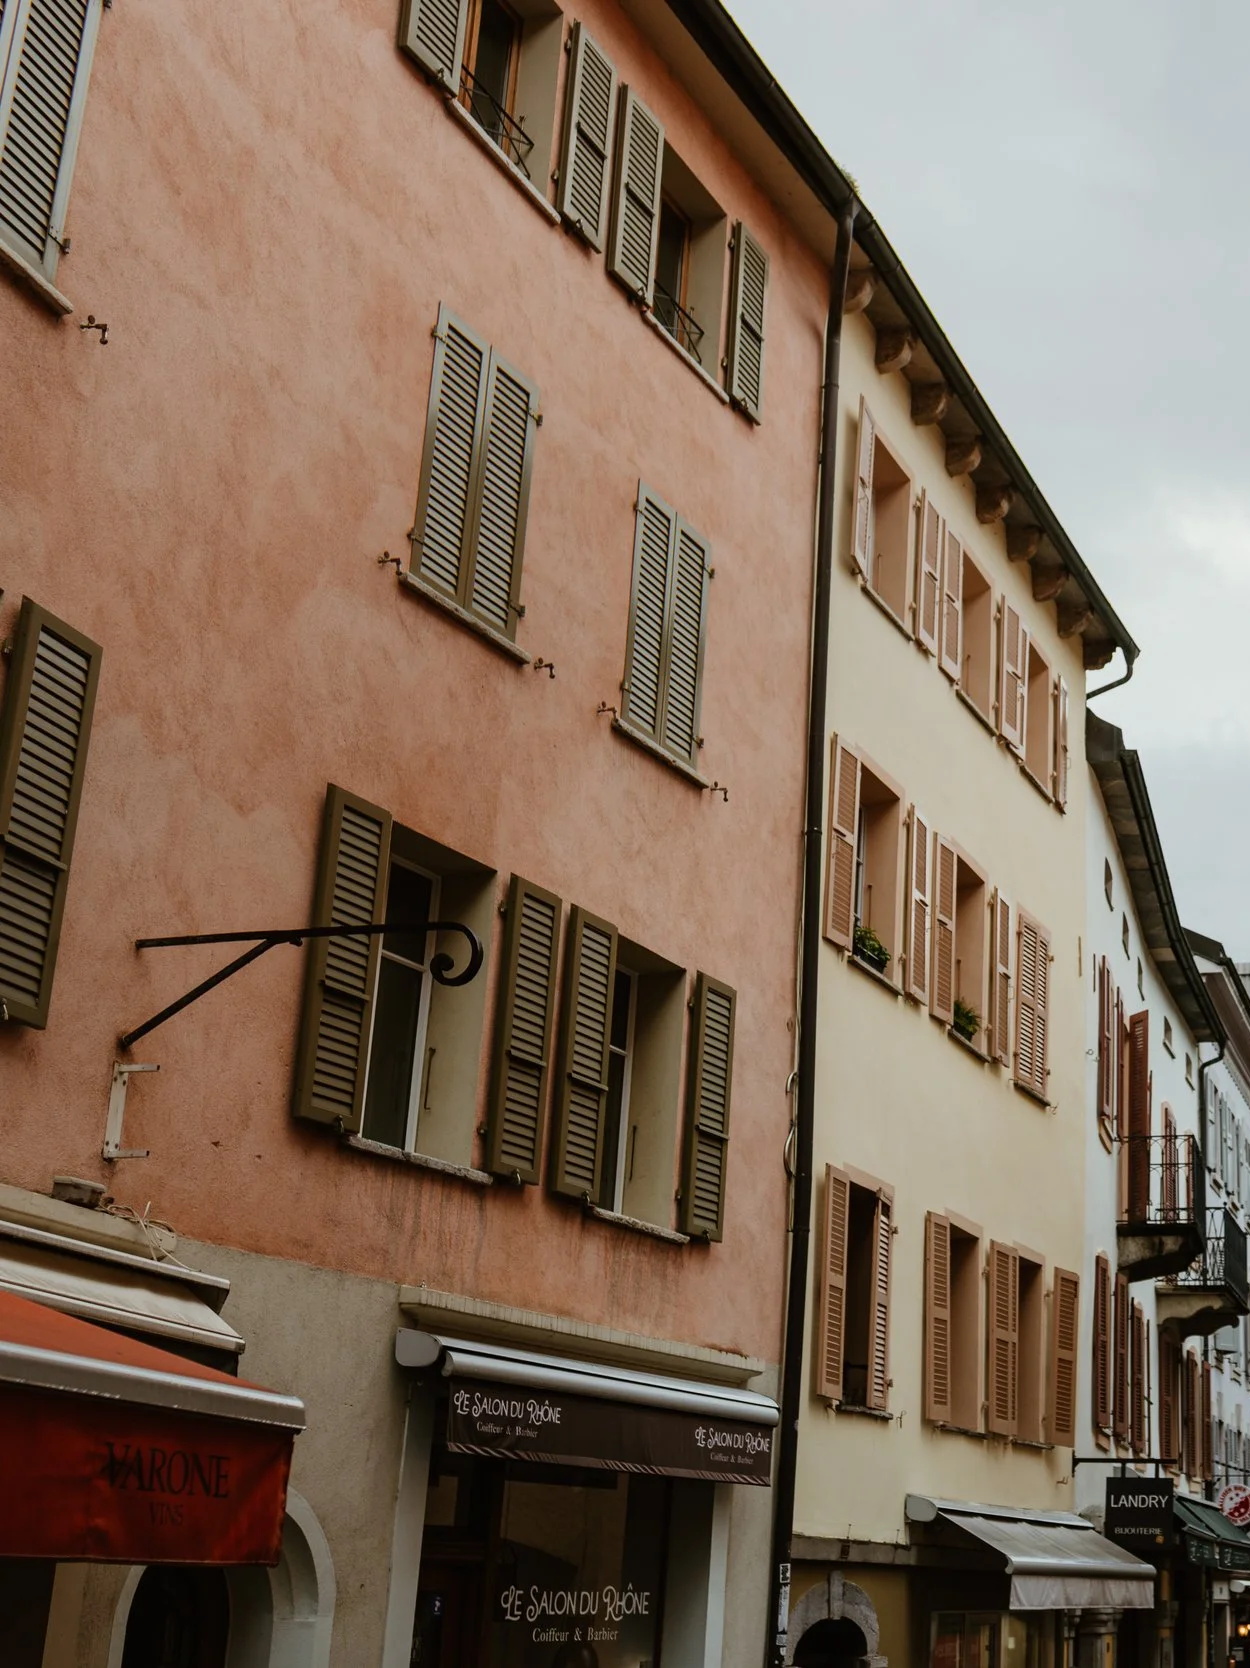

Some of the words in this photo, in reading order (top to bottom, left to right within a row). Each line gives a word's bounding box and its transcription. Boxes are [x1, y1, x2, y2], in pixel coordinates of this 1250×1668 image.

[453, 1390, 470, 1415] LE
[472, 1392, 509, 1418] SALON
[510, 1401, 525, 1418] DU
[526, 1400, 562, 1425] RHÔNE
[476, 1421, 504, 1434] Coiffeur
[505, 1425, 511, 1435] &
[694, 1426, 706, 1447] LE
[707, 1427, 733, 1449] SALON
[733, 1433, 744, 1449] DU
[745, 1432, 770, 1454] RHÔNE
[101, 1441, 231, 1498] VARONE
[1110, 1494, 1169, 1508] LANDRY
[149, 1502, 184, 1527] VINS
[1114, 1526, 1163, 1535] BIJOUTERIE
[500, 1585, 524, 1622] LE
[526, 1585, 577, 1622] SALON
[579, 1591, 600, 1615] DU
[602, 1582, 650, 1622] RHÔNE
[532, 1628, 569, 1642] Coiffeur
[574, 1627, 582, 1641] &
[587, 1627, 618, 1641] Barbier
